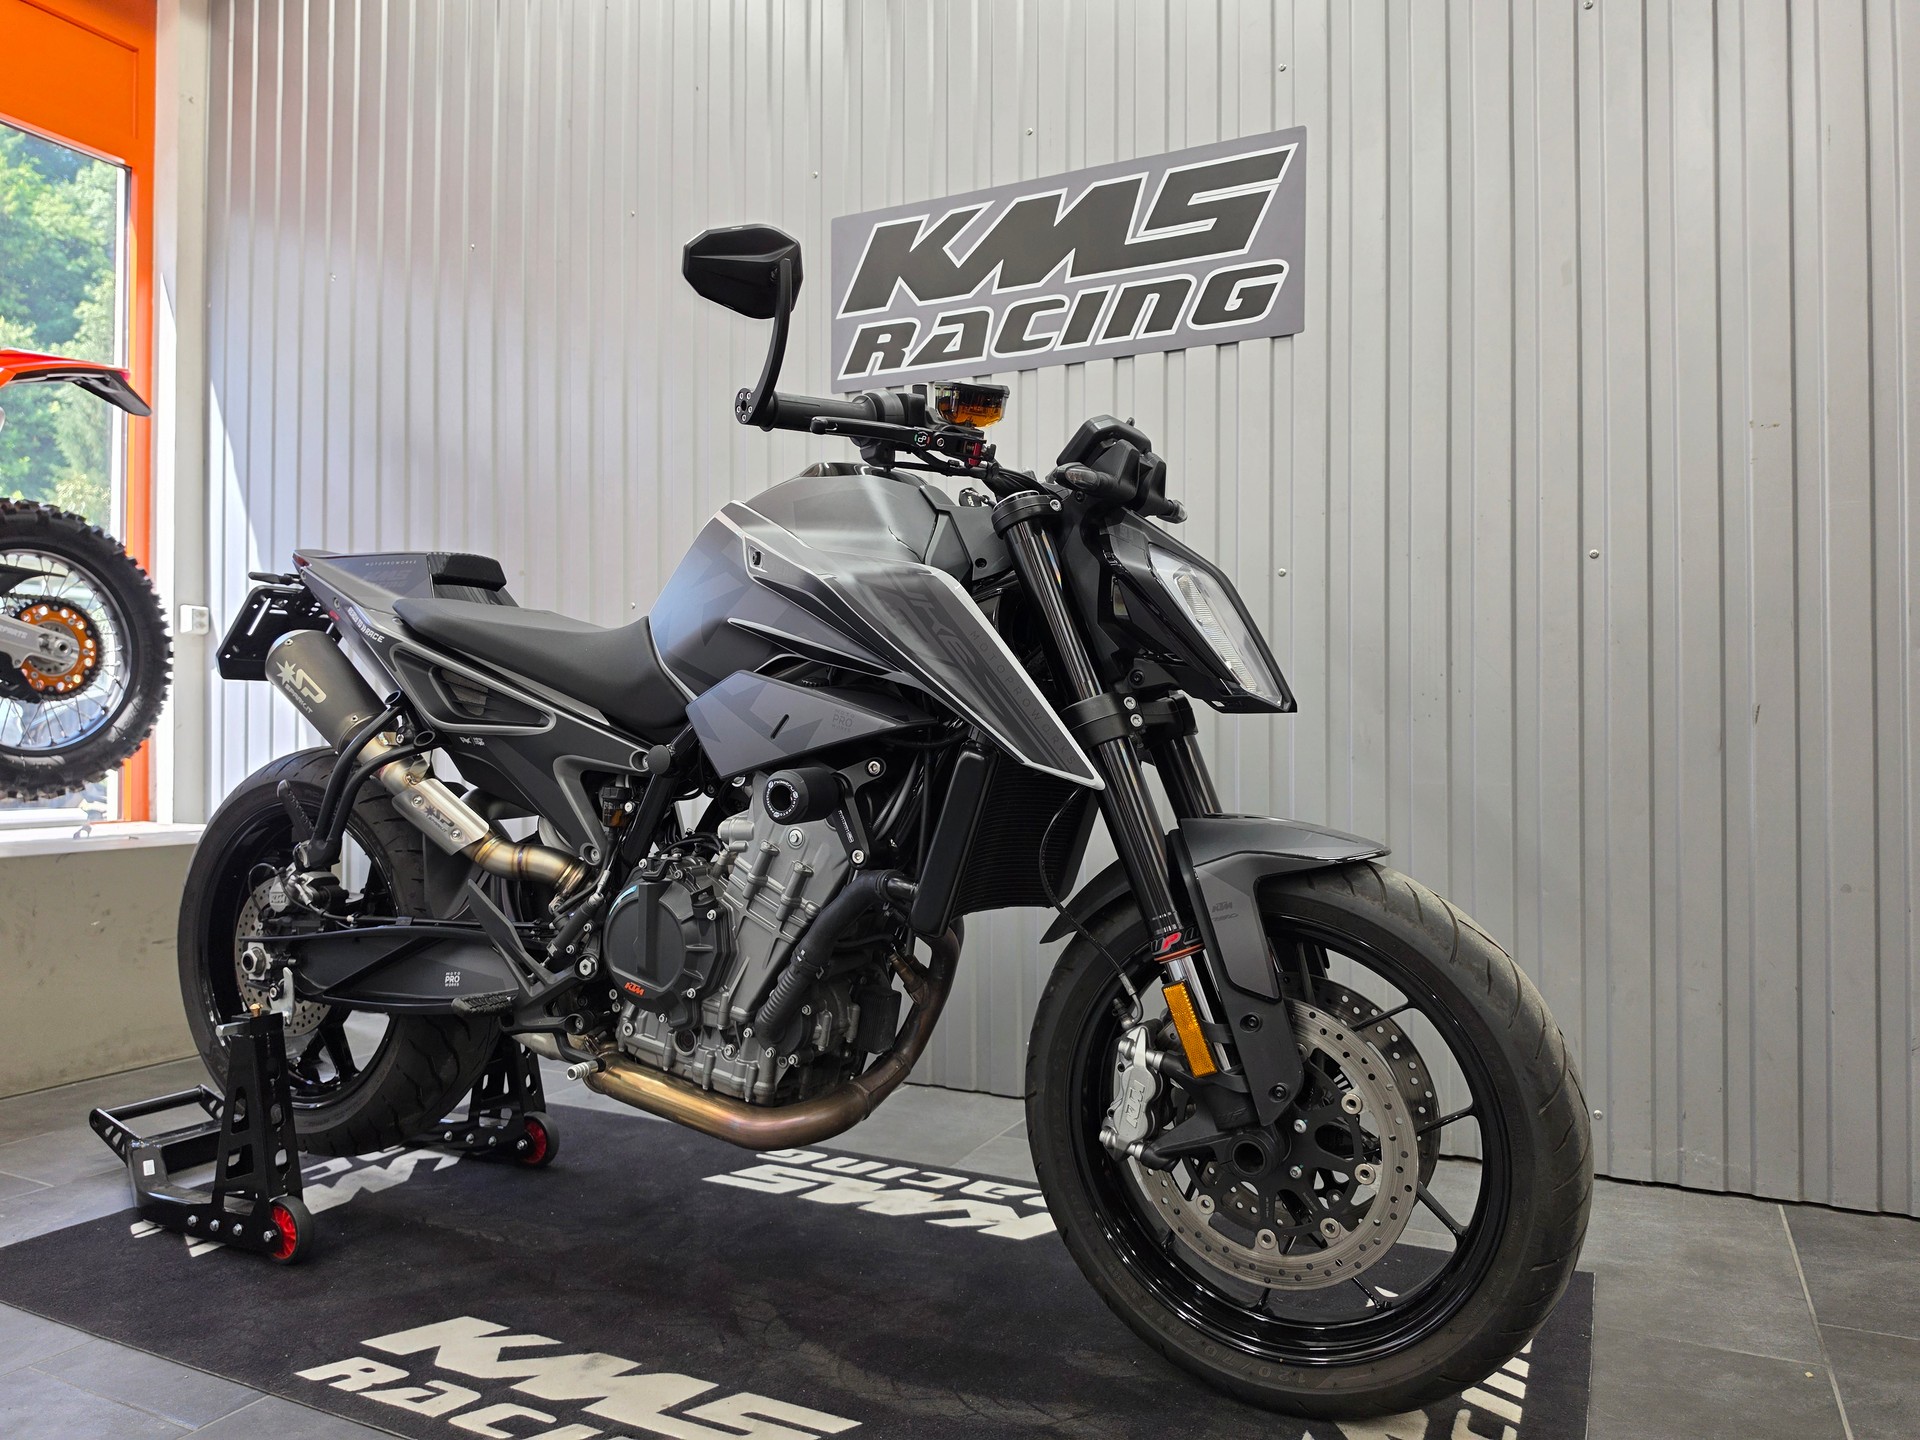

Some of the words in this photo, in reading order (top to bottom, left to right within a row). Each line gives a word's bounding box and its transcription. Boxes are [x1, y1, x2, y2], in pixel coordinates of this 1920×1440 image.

[836, 142, 1299, 320] KMS
[837, 259, 1290, 381] RACING
[832, 714, 853, 727] PRO
[970, 631, 1075, 764] MOTOPROWORKS
[444, 975, 461, 983] PRO
[624, 981, 645, 997] KTM
